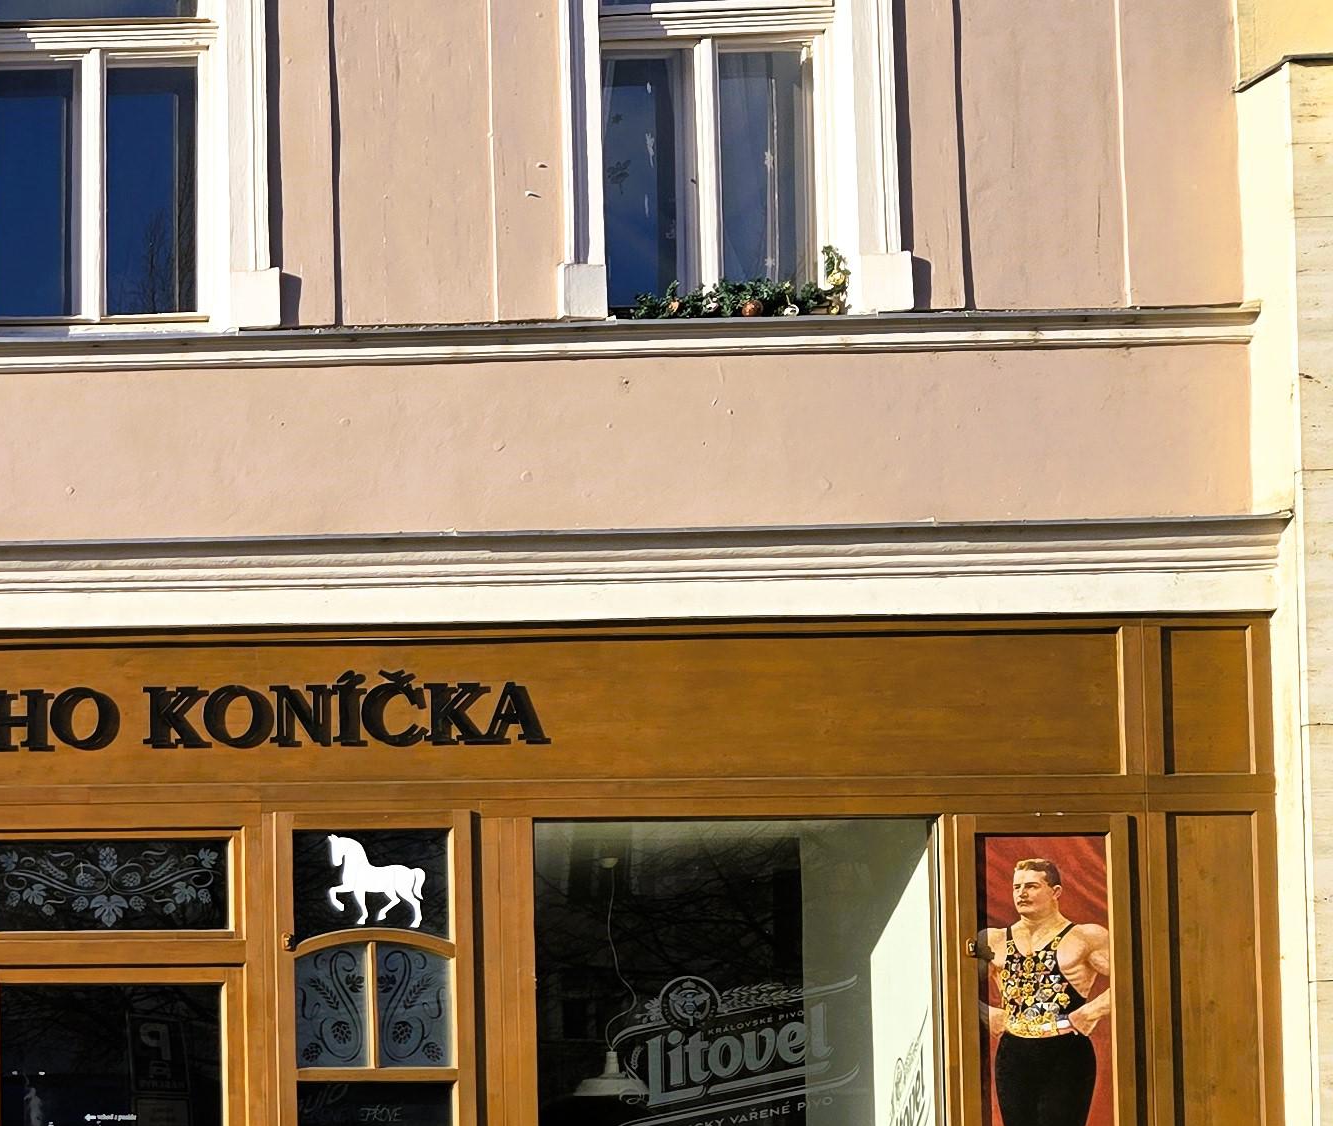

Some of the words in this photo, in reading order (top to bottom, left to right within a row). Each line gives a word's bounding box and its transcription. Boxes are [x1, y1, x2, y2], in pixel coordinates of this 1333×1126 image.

[143, 669, 552, 748] KONÍČKA
[778, 1010, 805, 1021] PIVO
[646, 1002, 834, 1107] Litovel
[729, 1101, 791, 1125] VAŘENÉ
[796, 1096, 833, 1112] PIVO
